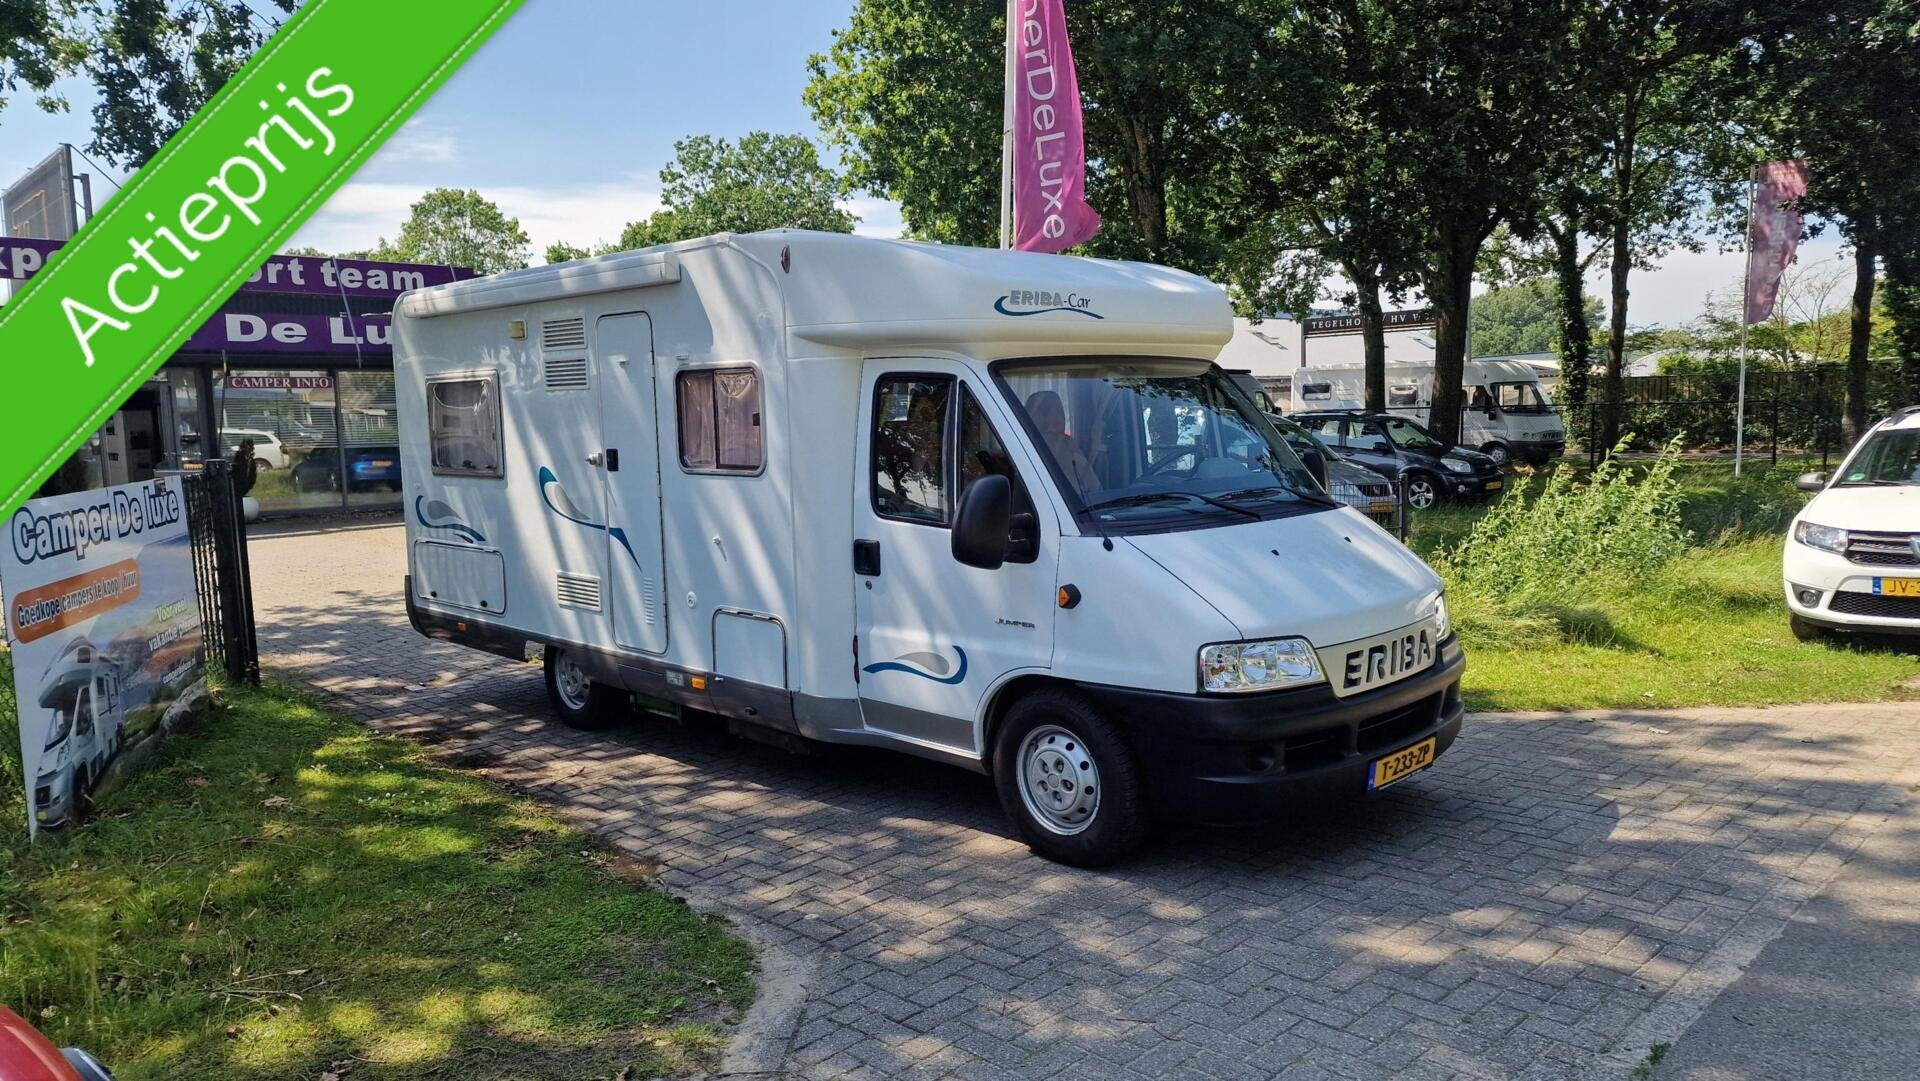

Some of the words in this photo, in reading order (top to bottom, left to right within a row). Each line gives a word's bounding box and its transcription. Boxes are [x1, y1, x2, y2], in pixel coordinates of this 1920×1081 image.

[320, 260, 425, 290] team
[225, 313, 307, 343] De
[329, 316, 393, 345] Lu
[1312, 317, 1361, 329] TEGELHO
[231, 377, 291, 388] CAMPER
[297, 377, 329, 388] INFO
[12, 505, 112, 565] Camper
[113, 490, 144, 538] De
[143, 485, 180, 530] luxe
[1888, 579, 1920, 594] JV-
[17, 600, 60, 628] Goedkope
[62, 585, 95, 613] campers
[1343, 629, 1431, 689] ERIBA
[1382, 743, 1430, 781] T-233-ZP
